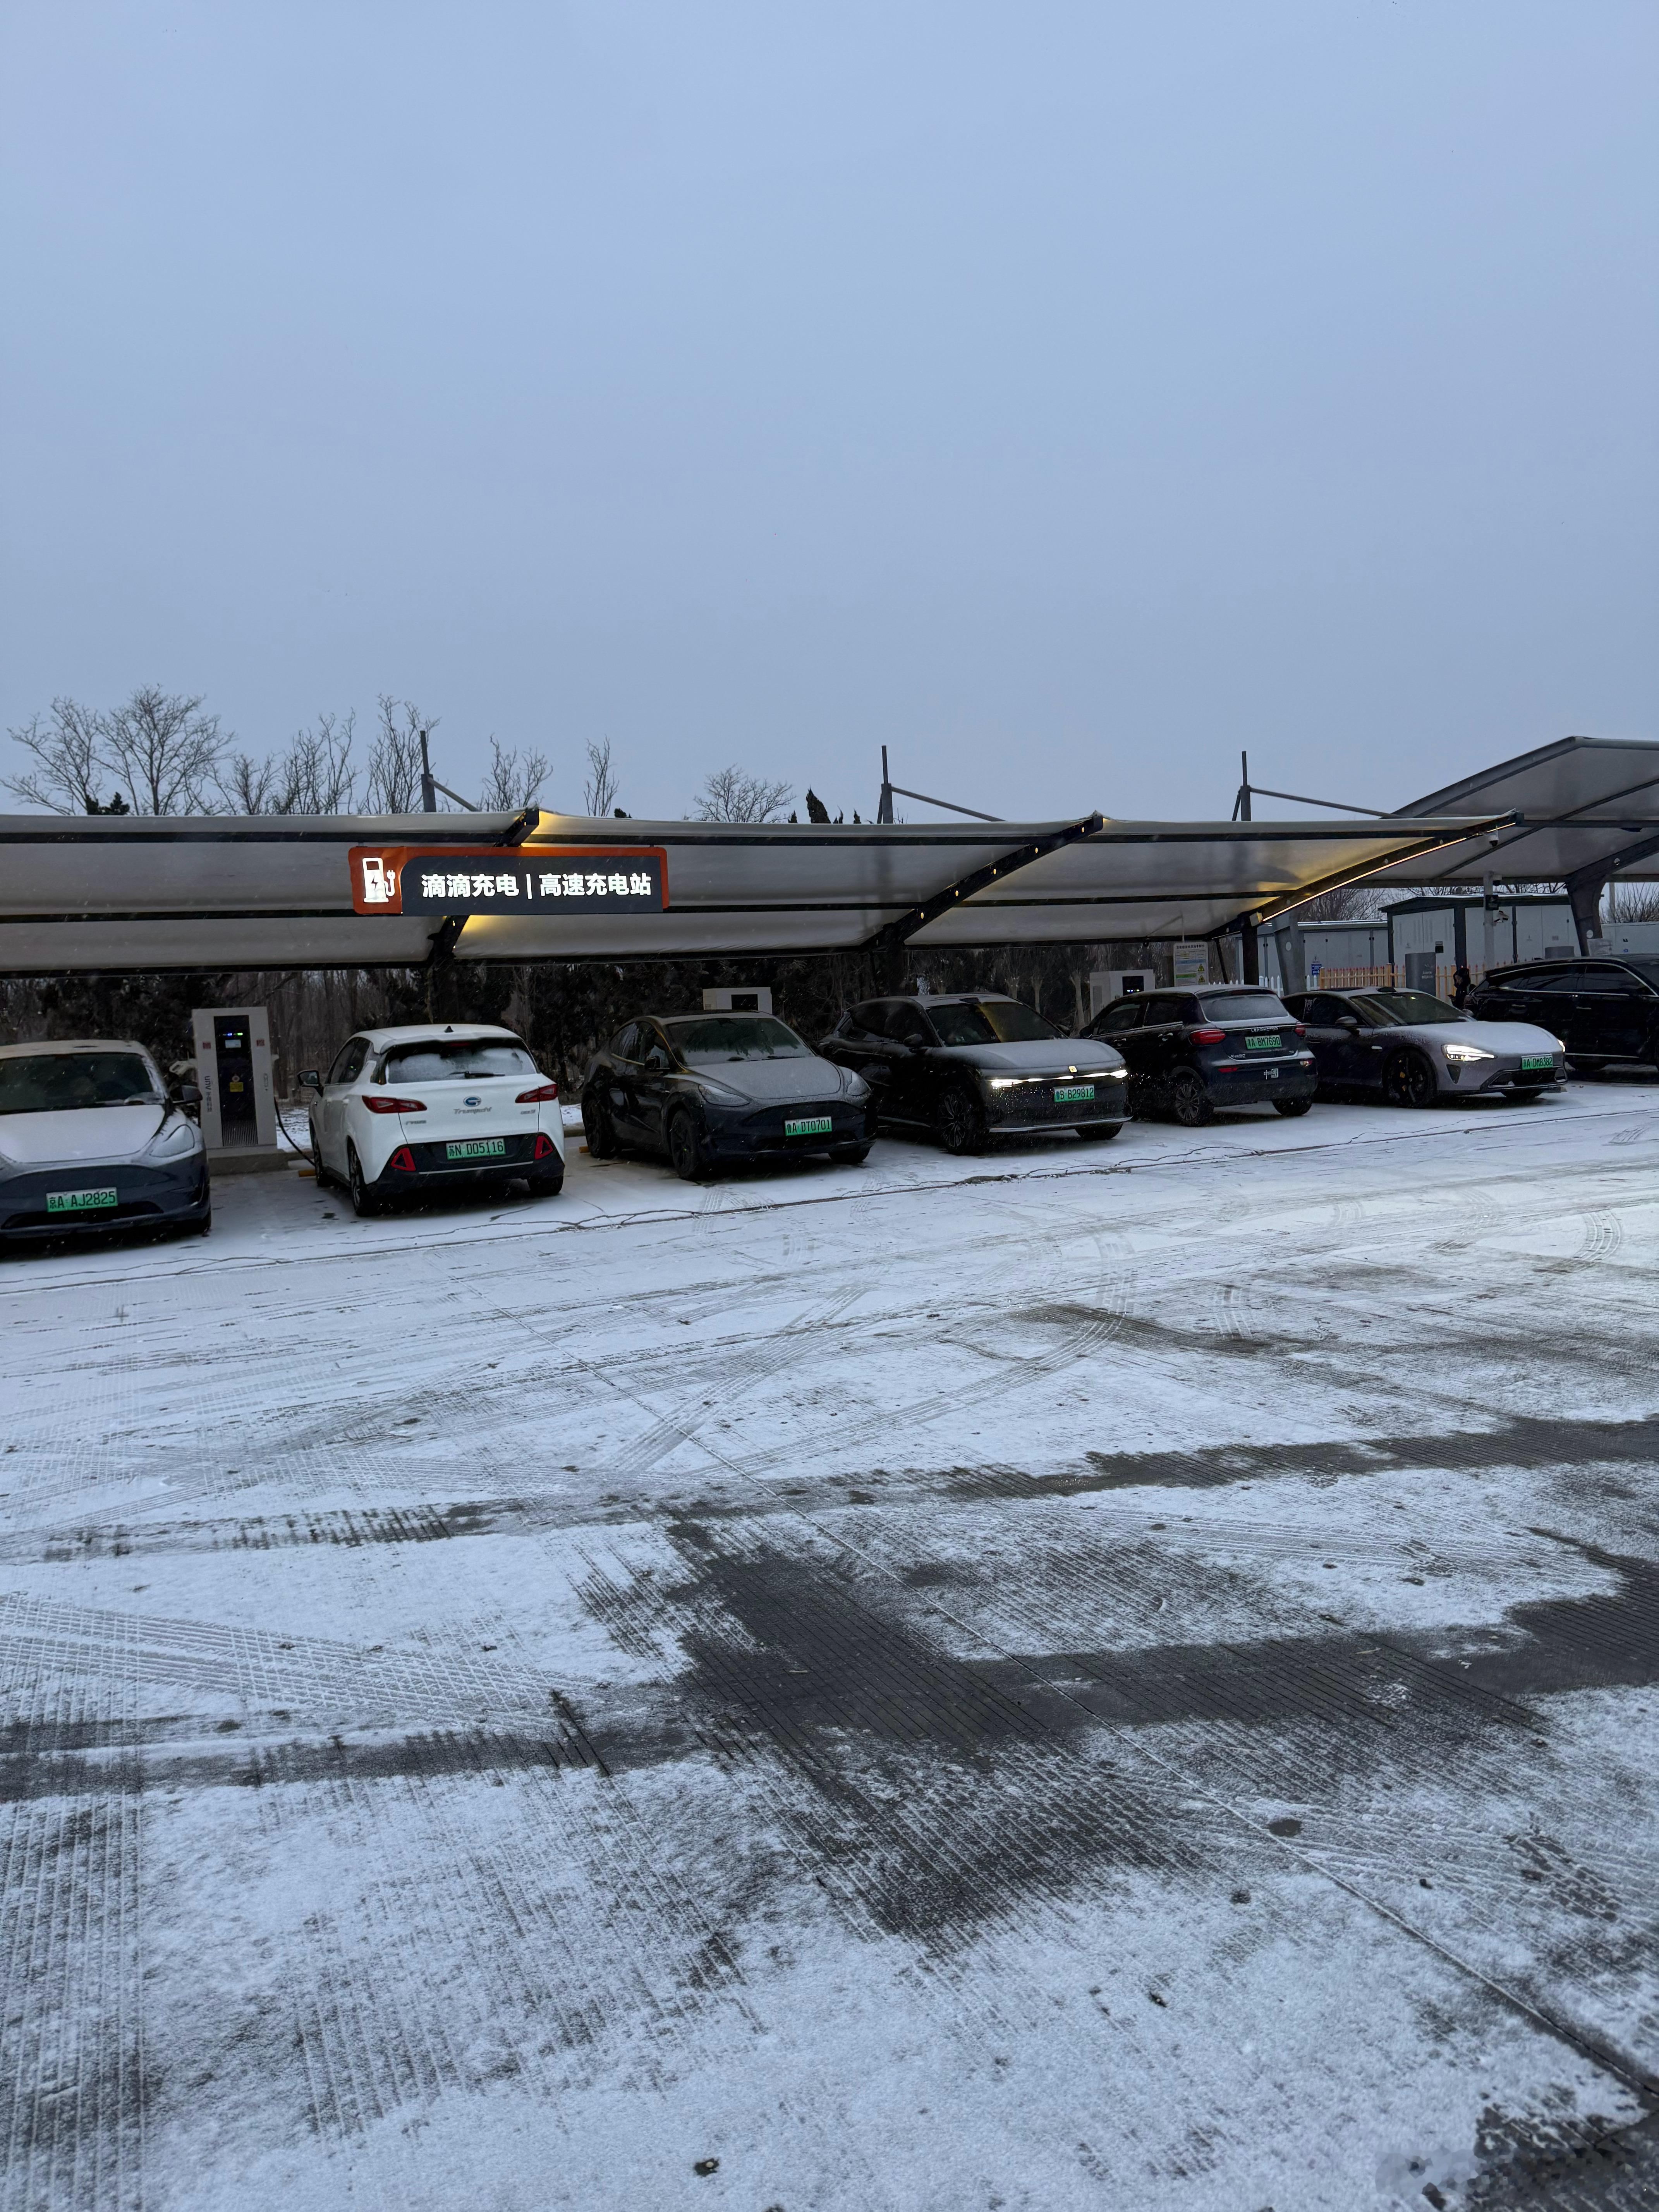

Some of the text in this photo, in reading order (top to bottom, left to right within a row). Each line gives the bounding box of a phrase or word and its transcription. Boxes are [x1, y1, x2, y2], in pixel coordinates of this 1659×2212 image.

[421, 873, 519, 898] 滴滴充电
[539, 872, 651, 897] 高速充电站
[71, 1191, 116, 1207] AJ2825
